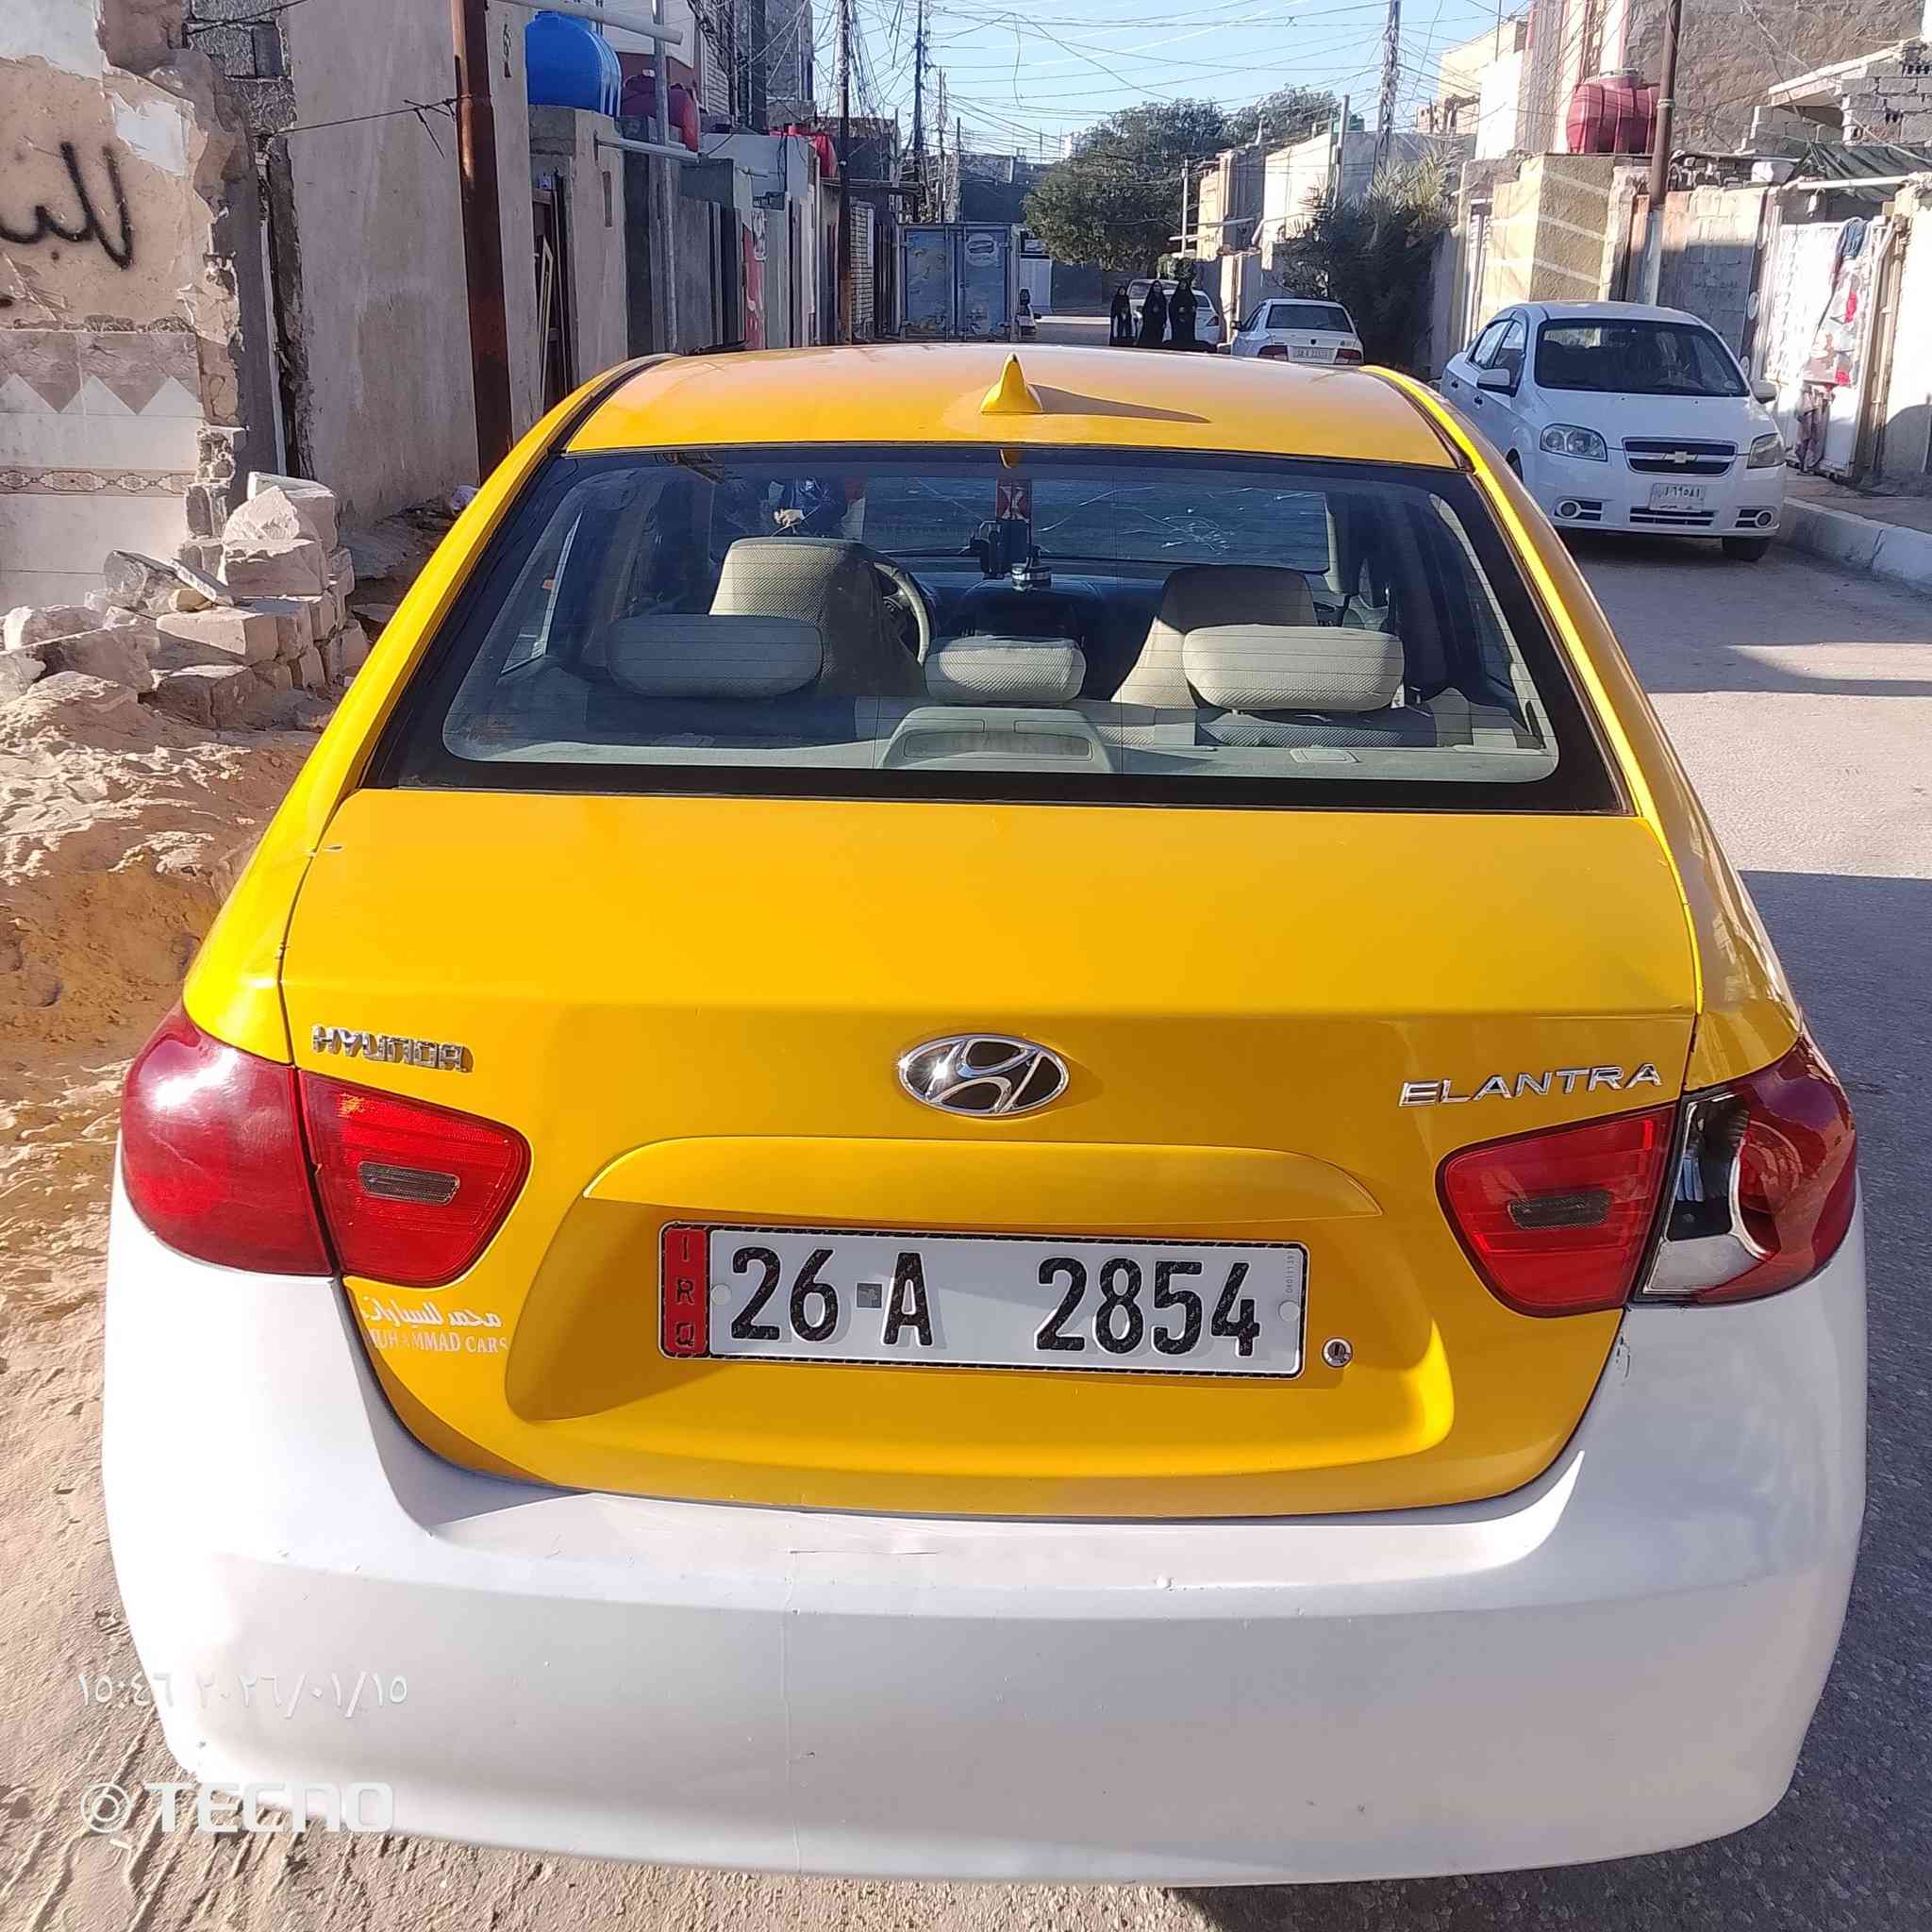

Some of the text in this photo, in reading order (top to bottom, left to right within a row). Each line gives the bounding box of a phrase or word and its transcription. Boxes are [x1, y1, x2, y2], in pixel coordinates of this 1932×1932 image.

[1399, 1063, 1663, 1107] ELANTRA
[675, 1237, 695, 1348] IRQ
[731, 1247, 839, 1342] 26
[882, 1251, 934, 1346] A
[1037, 1257, 1260, 1357] 2854
